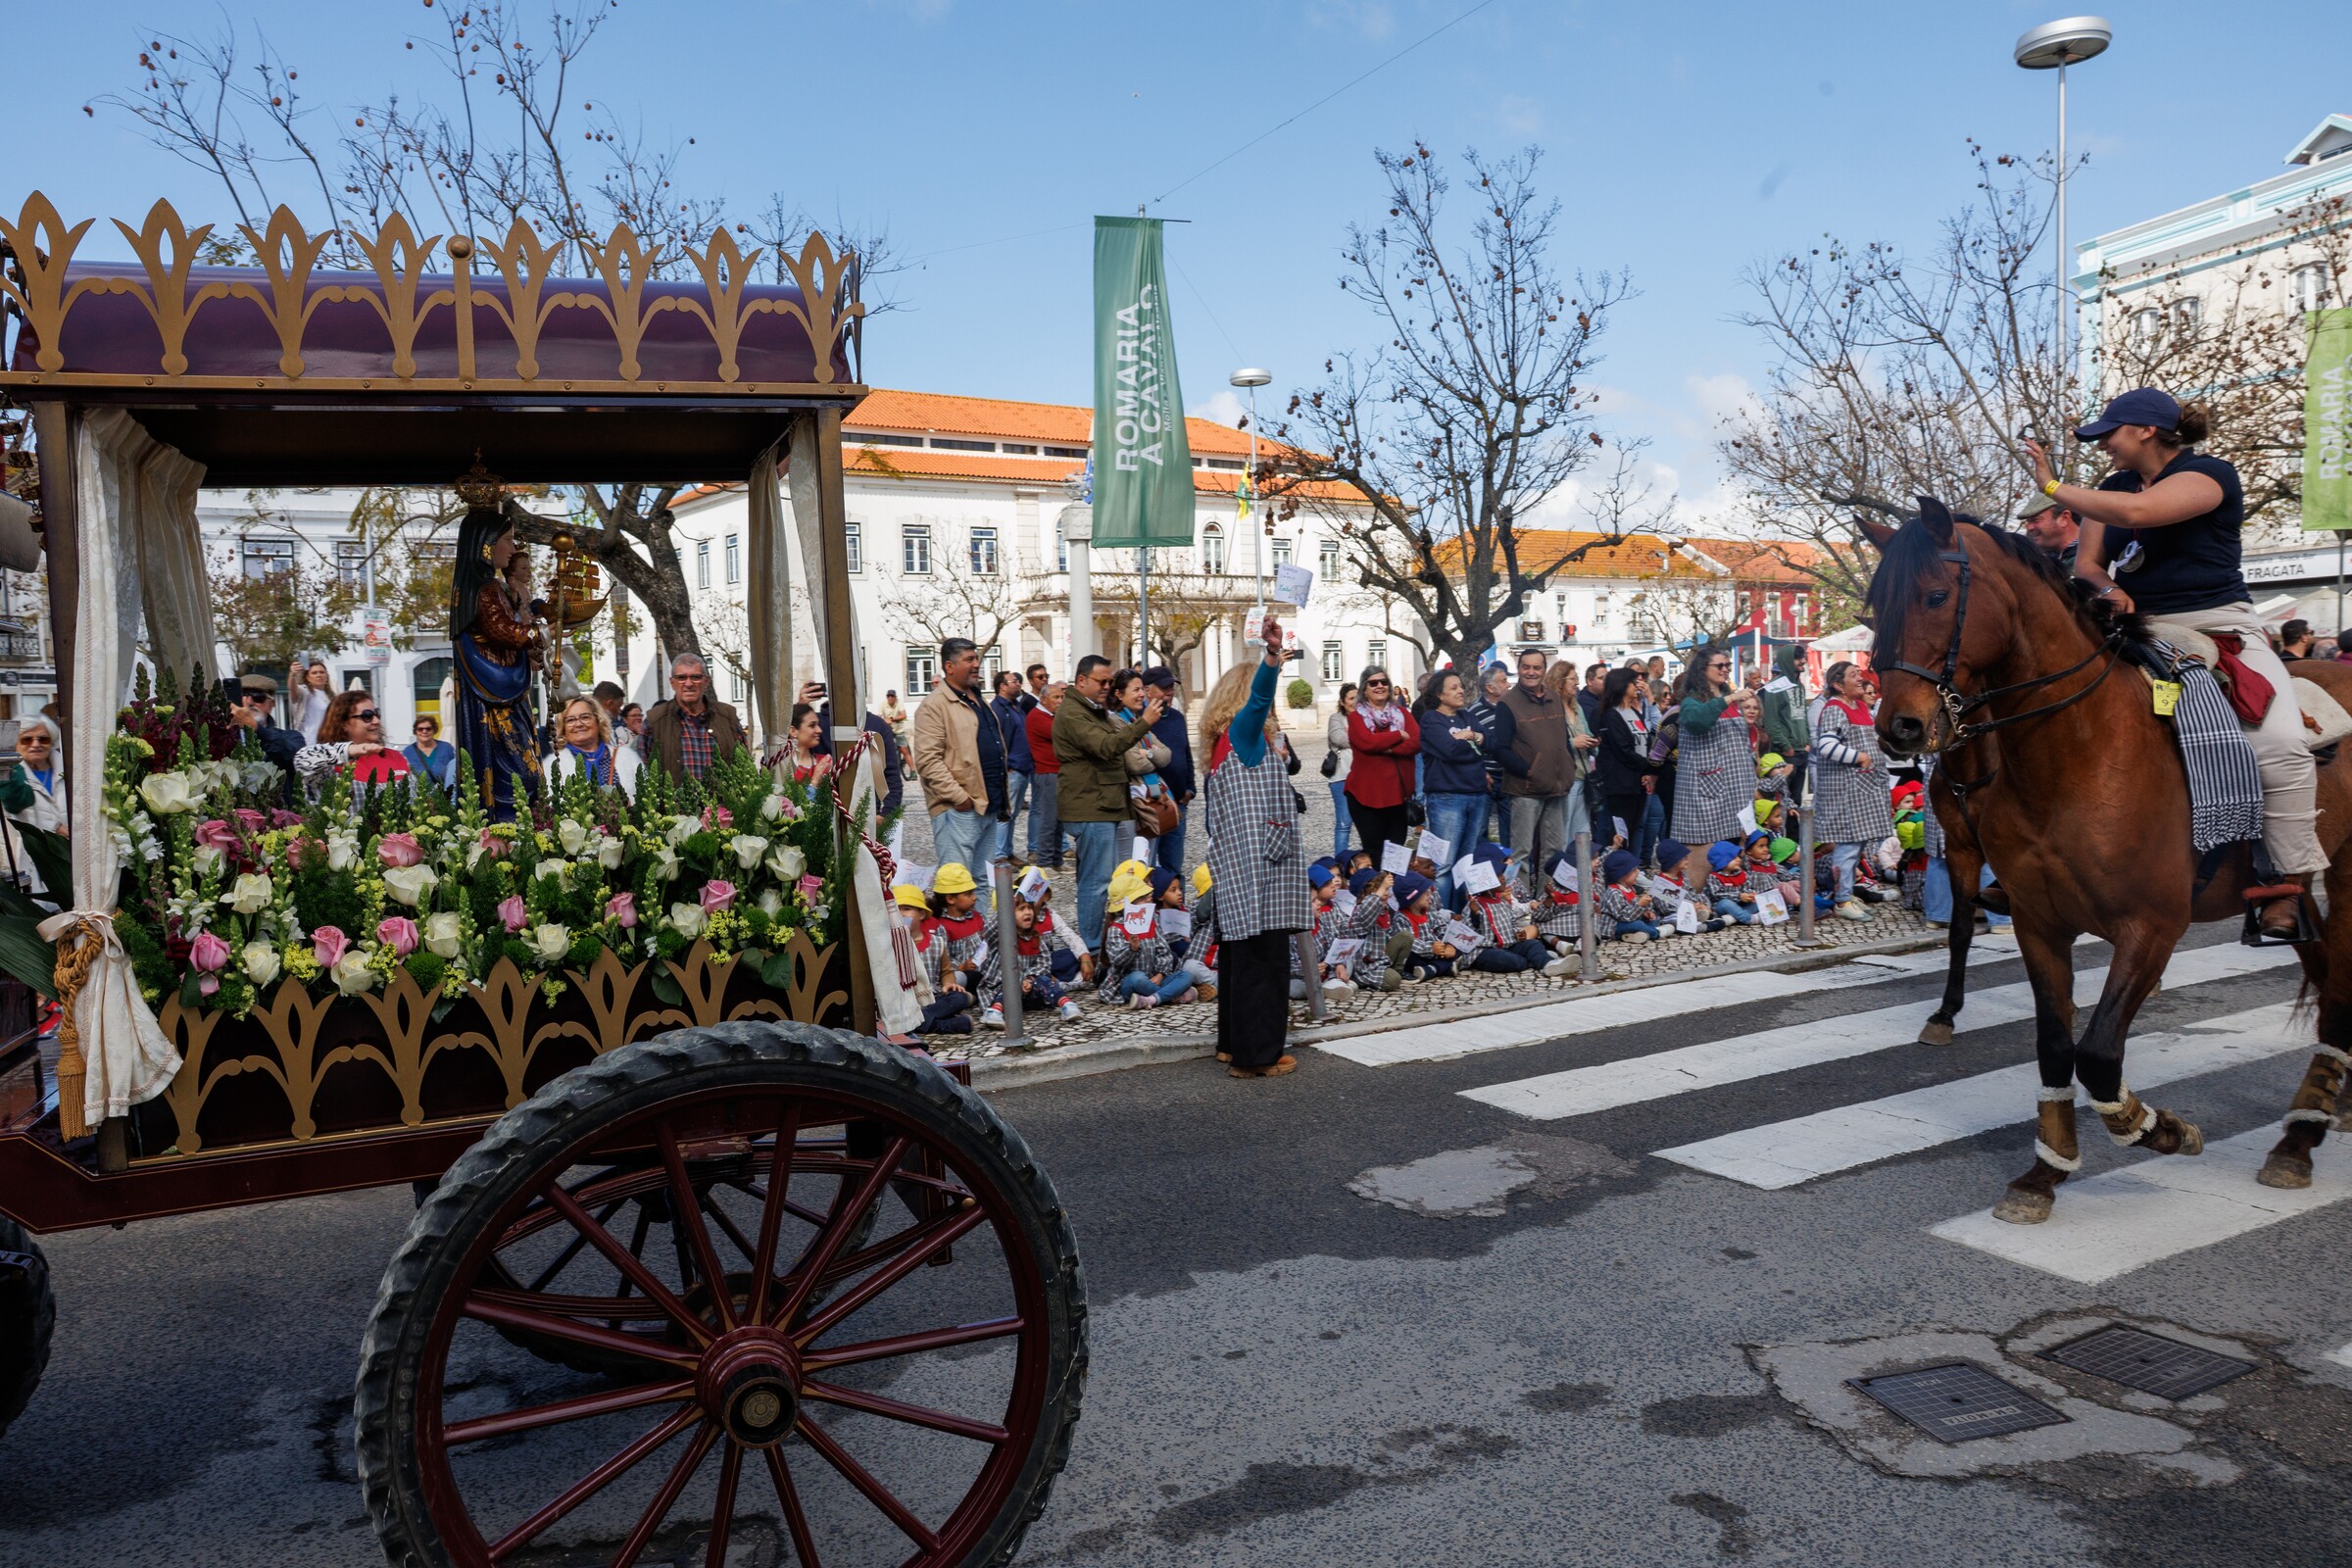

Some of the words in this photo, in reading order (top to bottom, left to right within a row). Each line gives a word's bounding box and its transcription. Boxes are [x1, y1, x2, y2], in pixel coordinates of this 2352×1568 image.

[1115, 303, 1141, 471] ROMARIA
[1140, 442, 1164, 466] A
[2319, 367, 2344, 479] ROMARIA
[2247, 564, 2305, 579] FRAGATA
